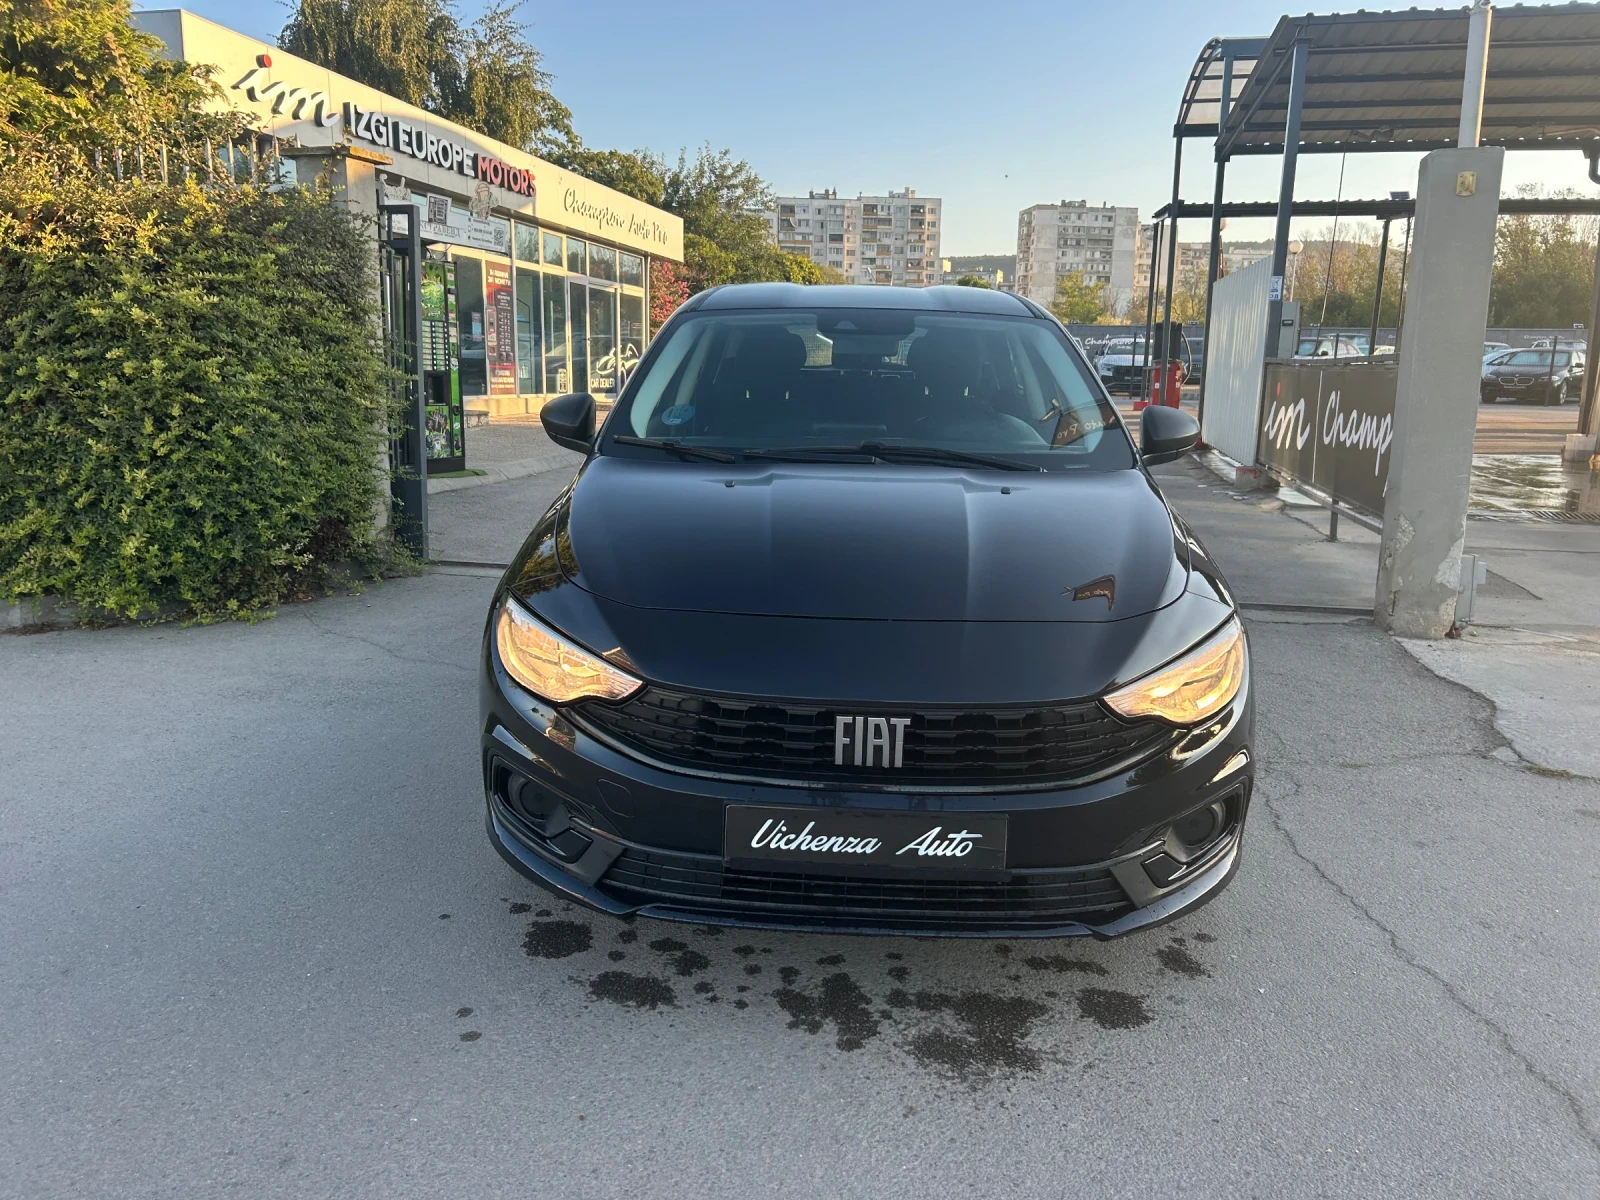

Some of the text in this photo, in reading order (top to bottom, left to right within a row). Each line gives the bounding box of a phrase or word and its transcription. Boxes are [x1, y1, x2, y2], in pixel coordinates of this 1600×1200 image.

[231, 54, 340, 127] im
[344, 102, 394, 148] IZGI
[398, 120, 475, 177] EUROPE
[563, 187, 669, 245] Champion Auto Pro
[1084, 337, 1133, 347] Champion
[591, 378, 615, 389] CAR DEALER
[1264, 382, 1394, 477] im Champ
[834, 715, 912, 769] FIAT
[750, 818, 984, 858] Vichenza Auto
